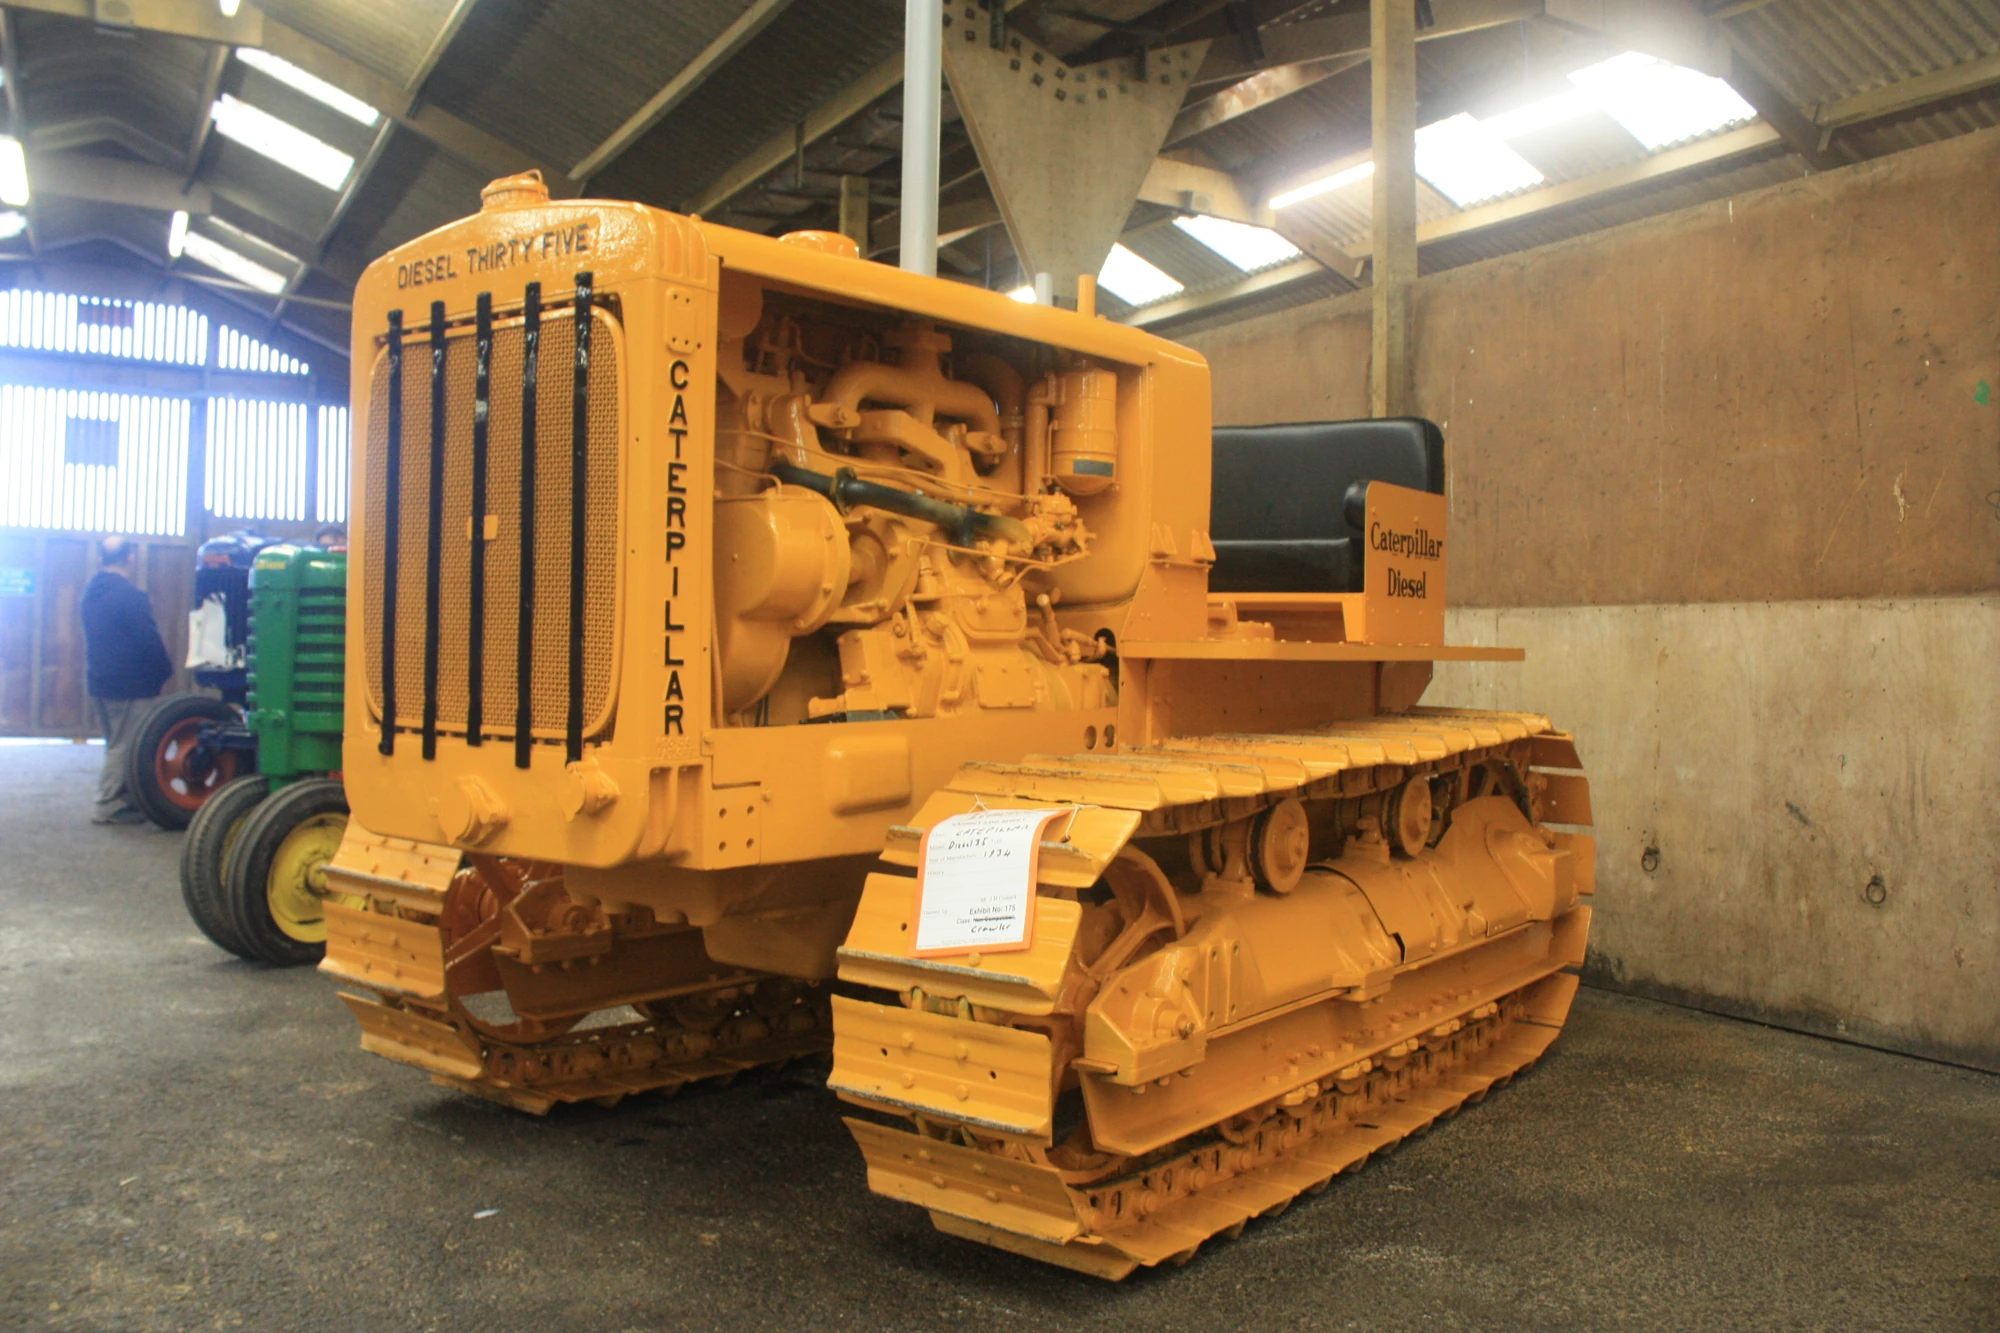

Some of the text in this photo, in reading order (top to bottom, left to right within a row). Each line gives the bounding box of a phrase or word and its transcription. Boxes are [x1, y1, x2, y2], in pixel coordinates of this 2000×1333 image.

[398, 224, 589, 289] DIESEL THIRTY FIVE
[664, 360, 689, 735] CATERPILLAR
[1371, 522, 1443, 558] Caterpillar
[1387, 568, 1427, 599] Diesel
[969, 906, 991, 916] Exhibit
[1005, 904, 1016, 913] 175
